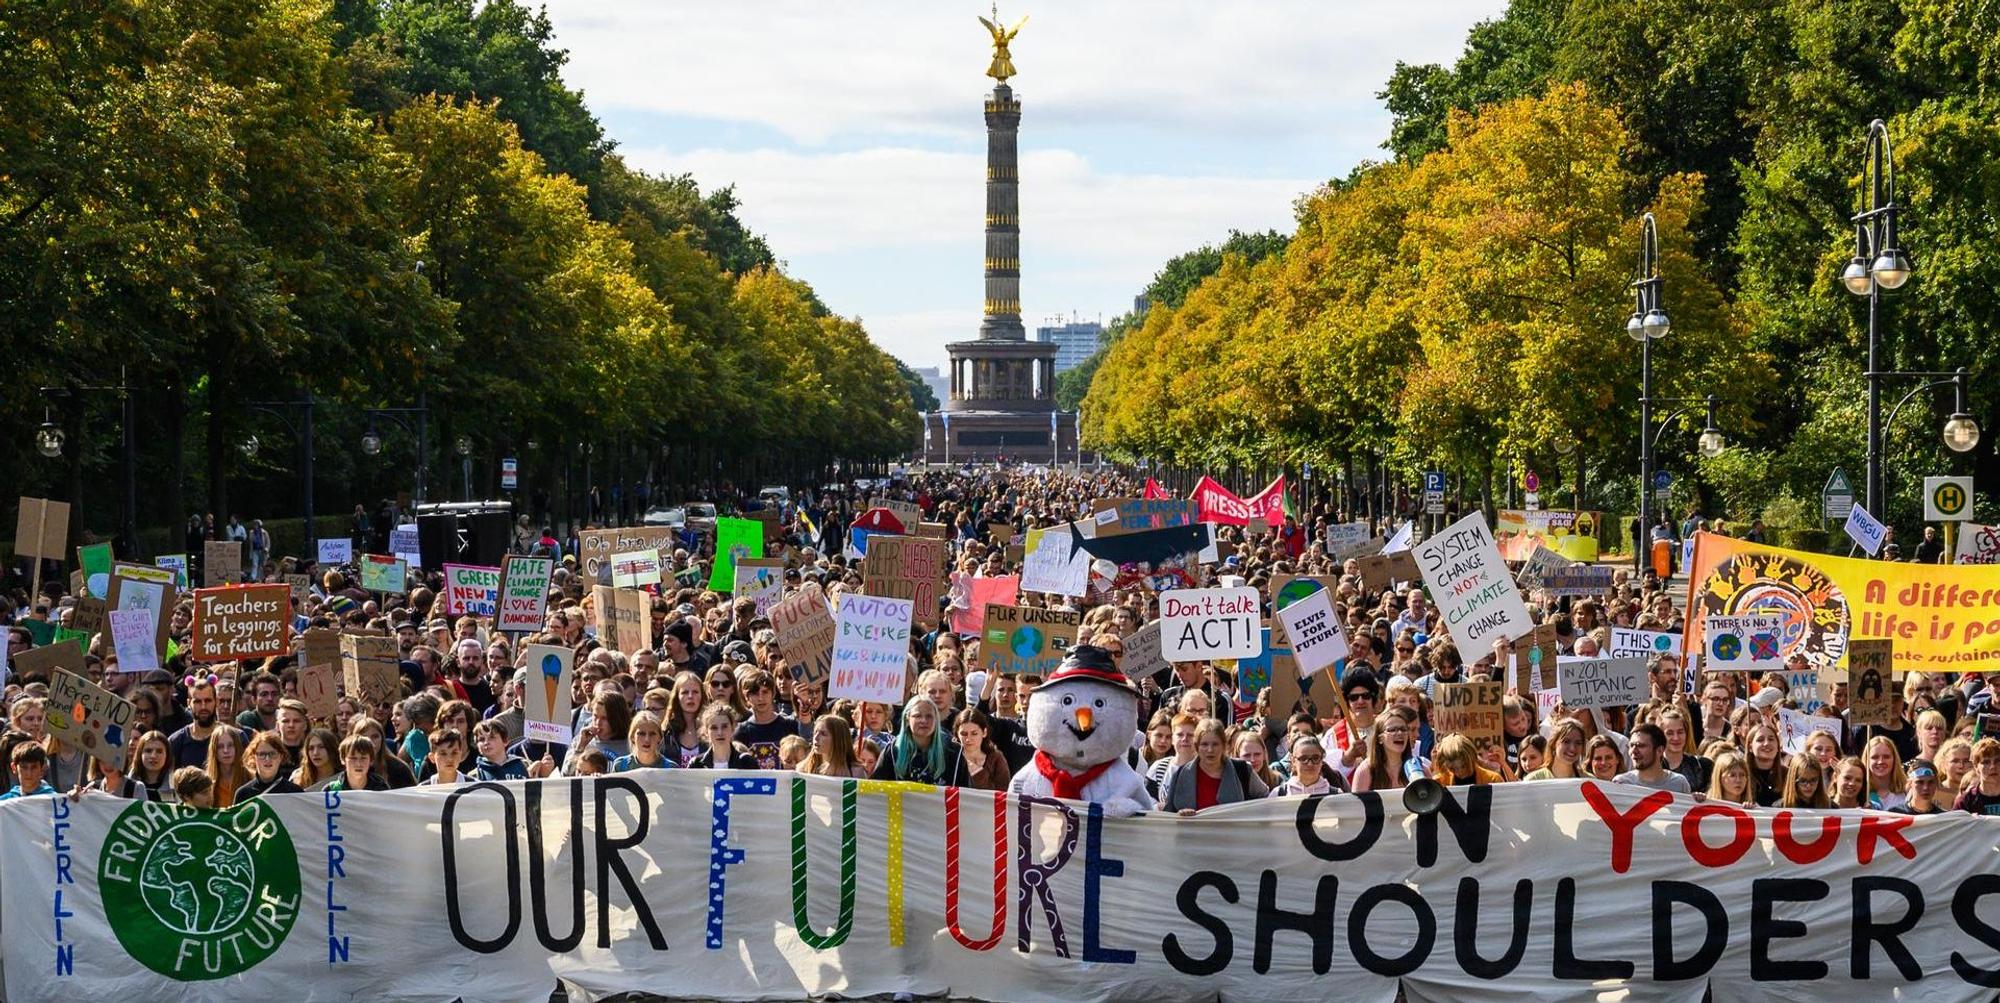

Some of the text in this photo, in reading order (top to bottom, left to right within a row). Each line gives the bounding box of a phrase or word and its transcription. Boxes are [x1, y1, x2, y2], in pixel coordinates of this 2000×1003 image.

[1428, 474, 1439, 489] P
[1942, 490, 1957, 508] H
[1853, 511, 1881, 540] WBGU
[1423, 526, 1487, 572] SYSTEM
[457, 570, 500, 586] GREEN
[511, 559, 546, 575] HATE
[1438, 553, 1484, 588] CHANGE
[454, 587, 484, 599] NEW
[506, 578, 547, 587] CLIMATE
[510, 588, 541, 598] CHANGE
[1453, 574, 1479, 596] NOT
[1865, 579, 1886, 604] A
[200, 593, 278, 617] Teachers
[454, 600, 465, 613] 4
[772, 591, 824, 632] FUCK
[843, 597, 910, 622] AUTOS
[1165, 596, 1259, 618] Don't talk.
[1448, 580, 1510, 624] CLIMATE
[203, 614, 282, 638] in leggings
[504, 614, 541, 624] DANCING!
[1023, 608, 1079, 626] UNSERE
[1294, 609, 1326, 631] ELVIS
[1468, 610, 1511, 640] CHANGE
[1710, 619, 1767, 630] THERE IS NO
[1862, 612, 1918, 639] life
[1930, 615, 1955, 640] is
[1295, 625, 1340, 653] FUTURE
[1302, 621, 1327, 638] FOR
[1616, 632, 1651, 649] THIS
[203, 638, 280, 654] for future
[1565, 662, 1608, 679] IN 2019
[1789, 673, 1817, 686] AKE
[1478, 686, 1500, 705] ES
[1570, 676, 1636, 695] TITANIC
[1794, 688, 1817, 699] OVE
[103, 696, 132, 726] NO
[1562, 694, 1593, 707] would
[1437, 709, 1499, 731] WANDELT
[212, 801, 278, 852] OR
[1296, 781, 1917, 874] ON YOUR
[325, 791, 349, 963] BERLIN
[440, 776, 1136, 964] OUR FUTURE
[52, 797, 74, 976] BERLIN
[175, 884, 299, 973] FUTURE
[1162, 870, 2000, 988] SHOULDERS
